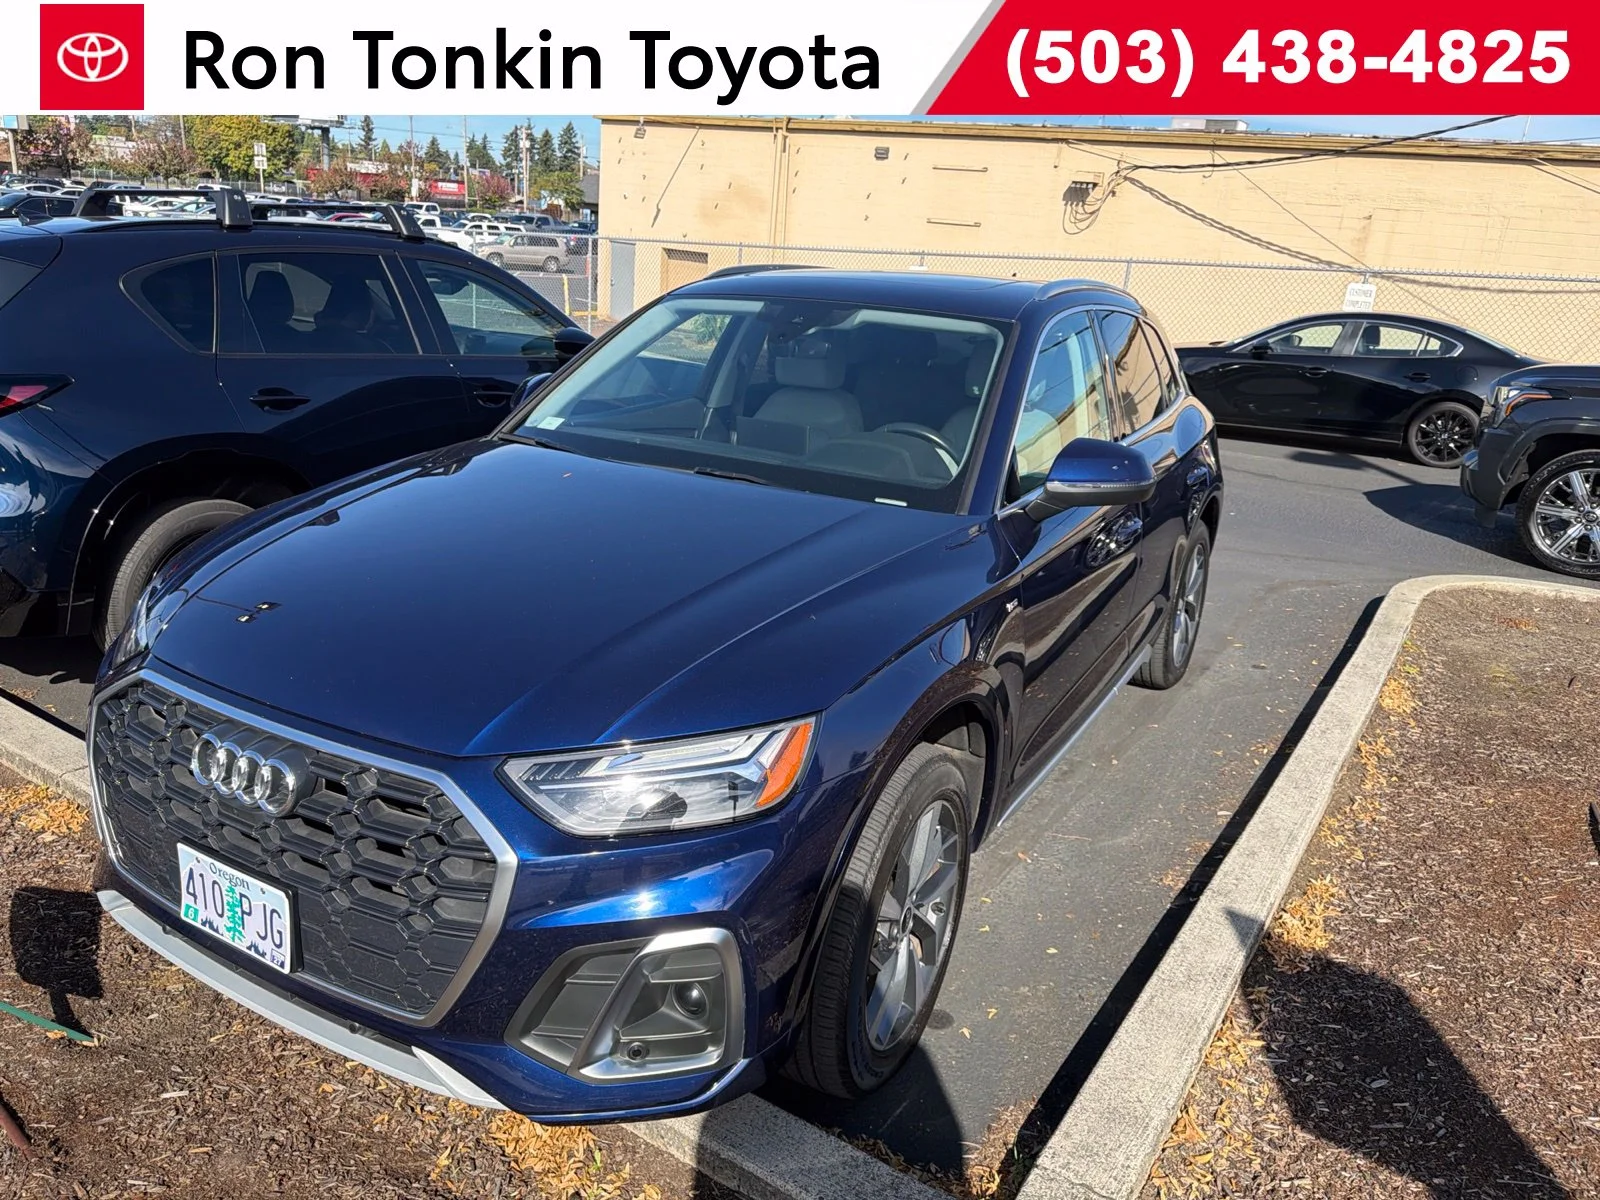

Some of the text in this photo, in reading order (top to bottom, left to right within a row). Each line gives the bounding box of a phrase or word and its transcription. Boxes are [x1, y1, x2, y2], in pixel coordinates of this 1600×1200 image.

[209, 862, 251, 891] Oregon
[185, 866, 283, 949] 410 PJG
[187, 907, 195, 919] 6
